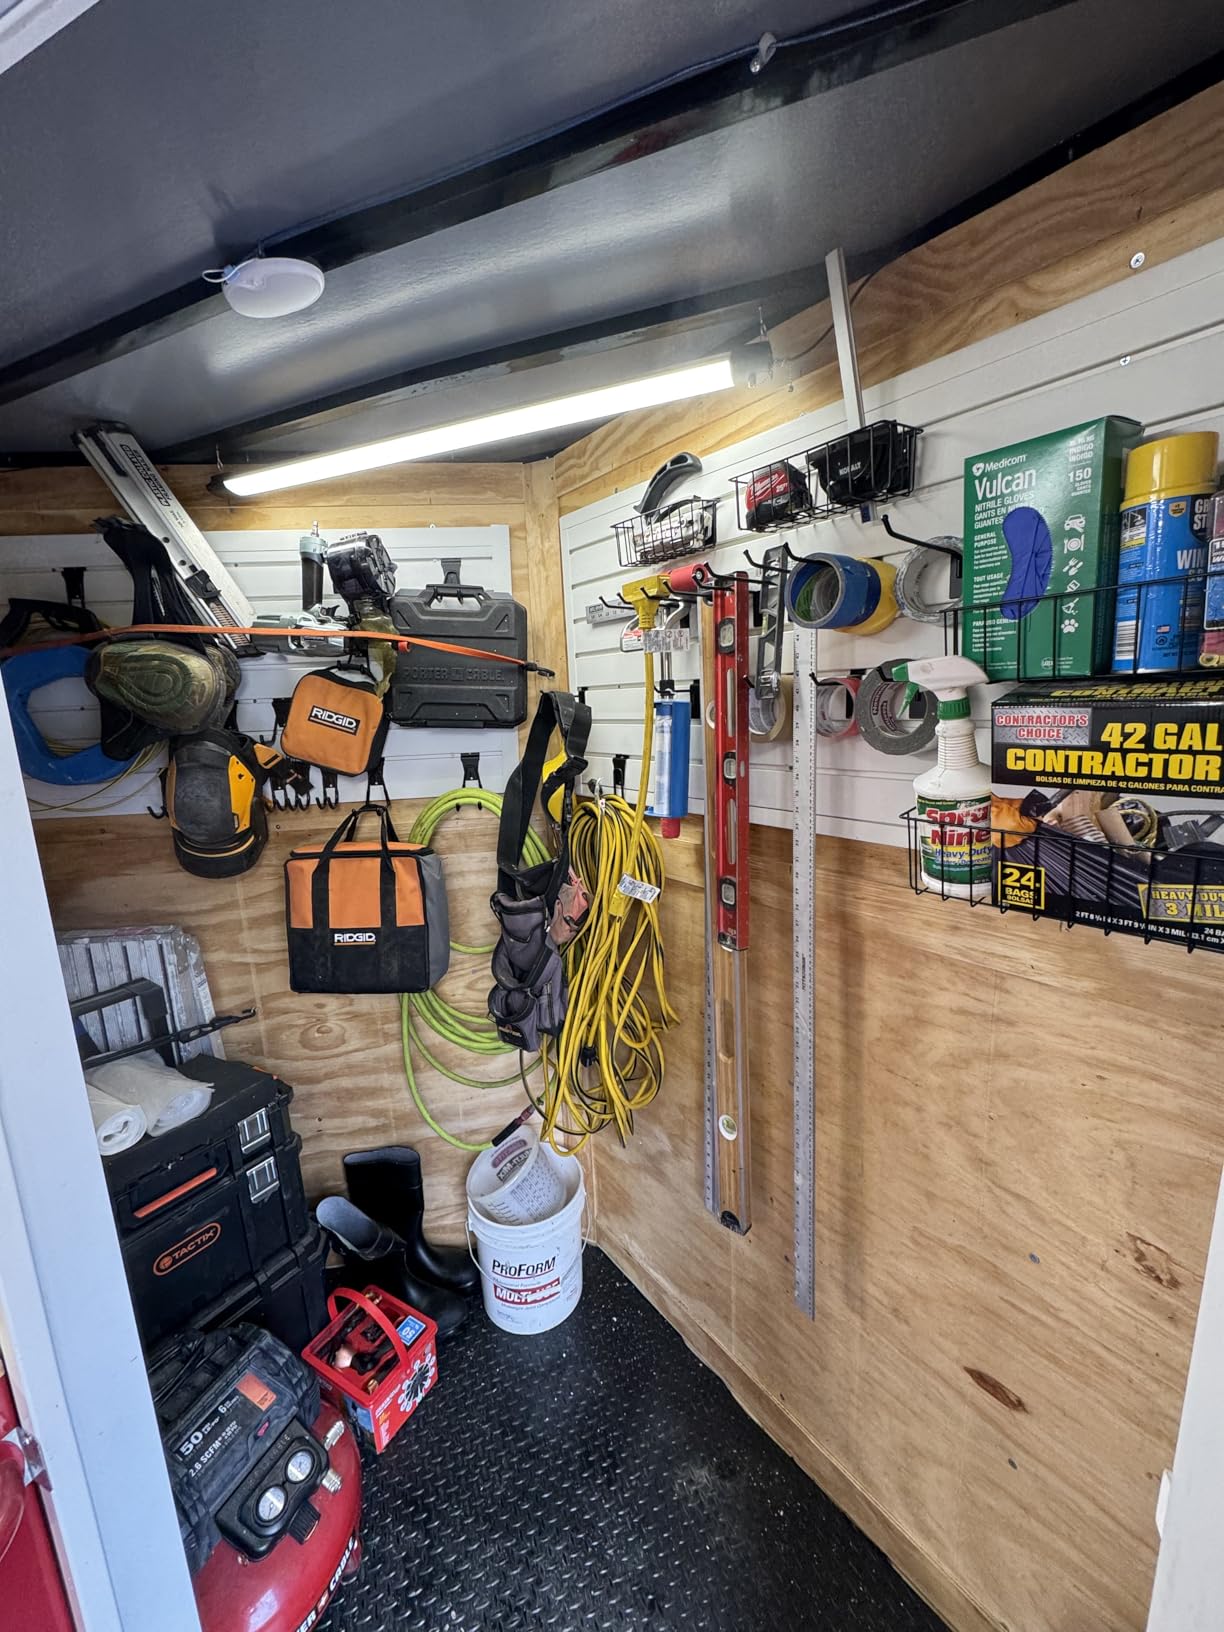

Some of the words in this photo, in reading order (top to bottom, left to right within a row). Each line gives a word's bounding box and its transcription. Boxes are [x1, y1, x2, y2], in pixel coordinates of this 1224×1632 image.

[984, 454, 1028, 473] Medicom
[1067, 467, 1092, 483] 150
[974, 469, 1038, 500] Vulcan
[974, 497, 1003, 512] NITRILE
[1004, 490, 1036, 505] GLOVES
[974, 508, 996, 520] GANTS
[997, 507, 1007, 516] EN
[403, 666, 448, 680] PORTER
[466, 668, 503, 681] CABLE
[311, 707, 357, 730] RIDGID
[995, 713, 1089, 726] CONTRACTOR'S
[1017, 727, 1063, 740] CHOICE
[1100, 722, 1147, 750] 42
[1153, 722, 1223, 751] GAL
[1006, 748, 1222, 781] CONTRACTOR
[1035, 775, 1063, 784] BOLSAS
[1063, 776, 1072, 784] DE
[1073, 777, 1106, 787] LIMPIEZA
[1107, 779, 1117, 788] DE
[1118, 780, 1127, 788] 42
[1128, 780, 1166, 791] GALONES
[1166, 783, 1190, 792] PARA
[931, 828, 991, 846] Nine
[1002, 867, 1040, 890] 24
[1152, 890, 1194, 900] HEAVY
[1165, 903, 1178, 916] 3
[1186, 903, 1224, 918] MIL
[333, 932, 376, 943] RIDGID
[1148, 923, 1157, 932] IN
[1158, 925, 1165, 933] X
[1171, 928, 1186, 937] MIL
[172, 1228, 215, 1261] TACTIX
[188, 1462, 202, 1478] 2.6
